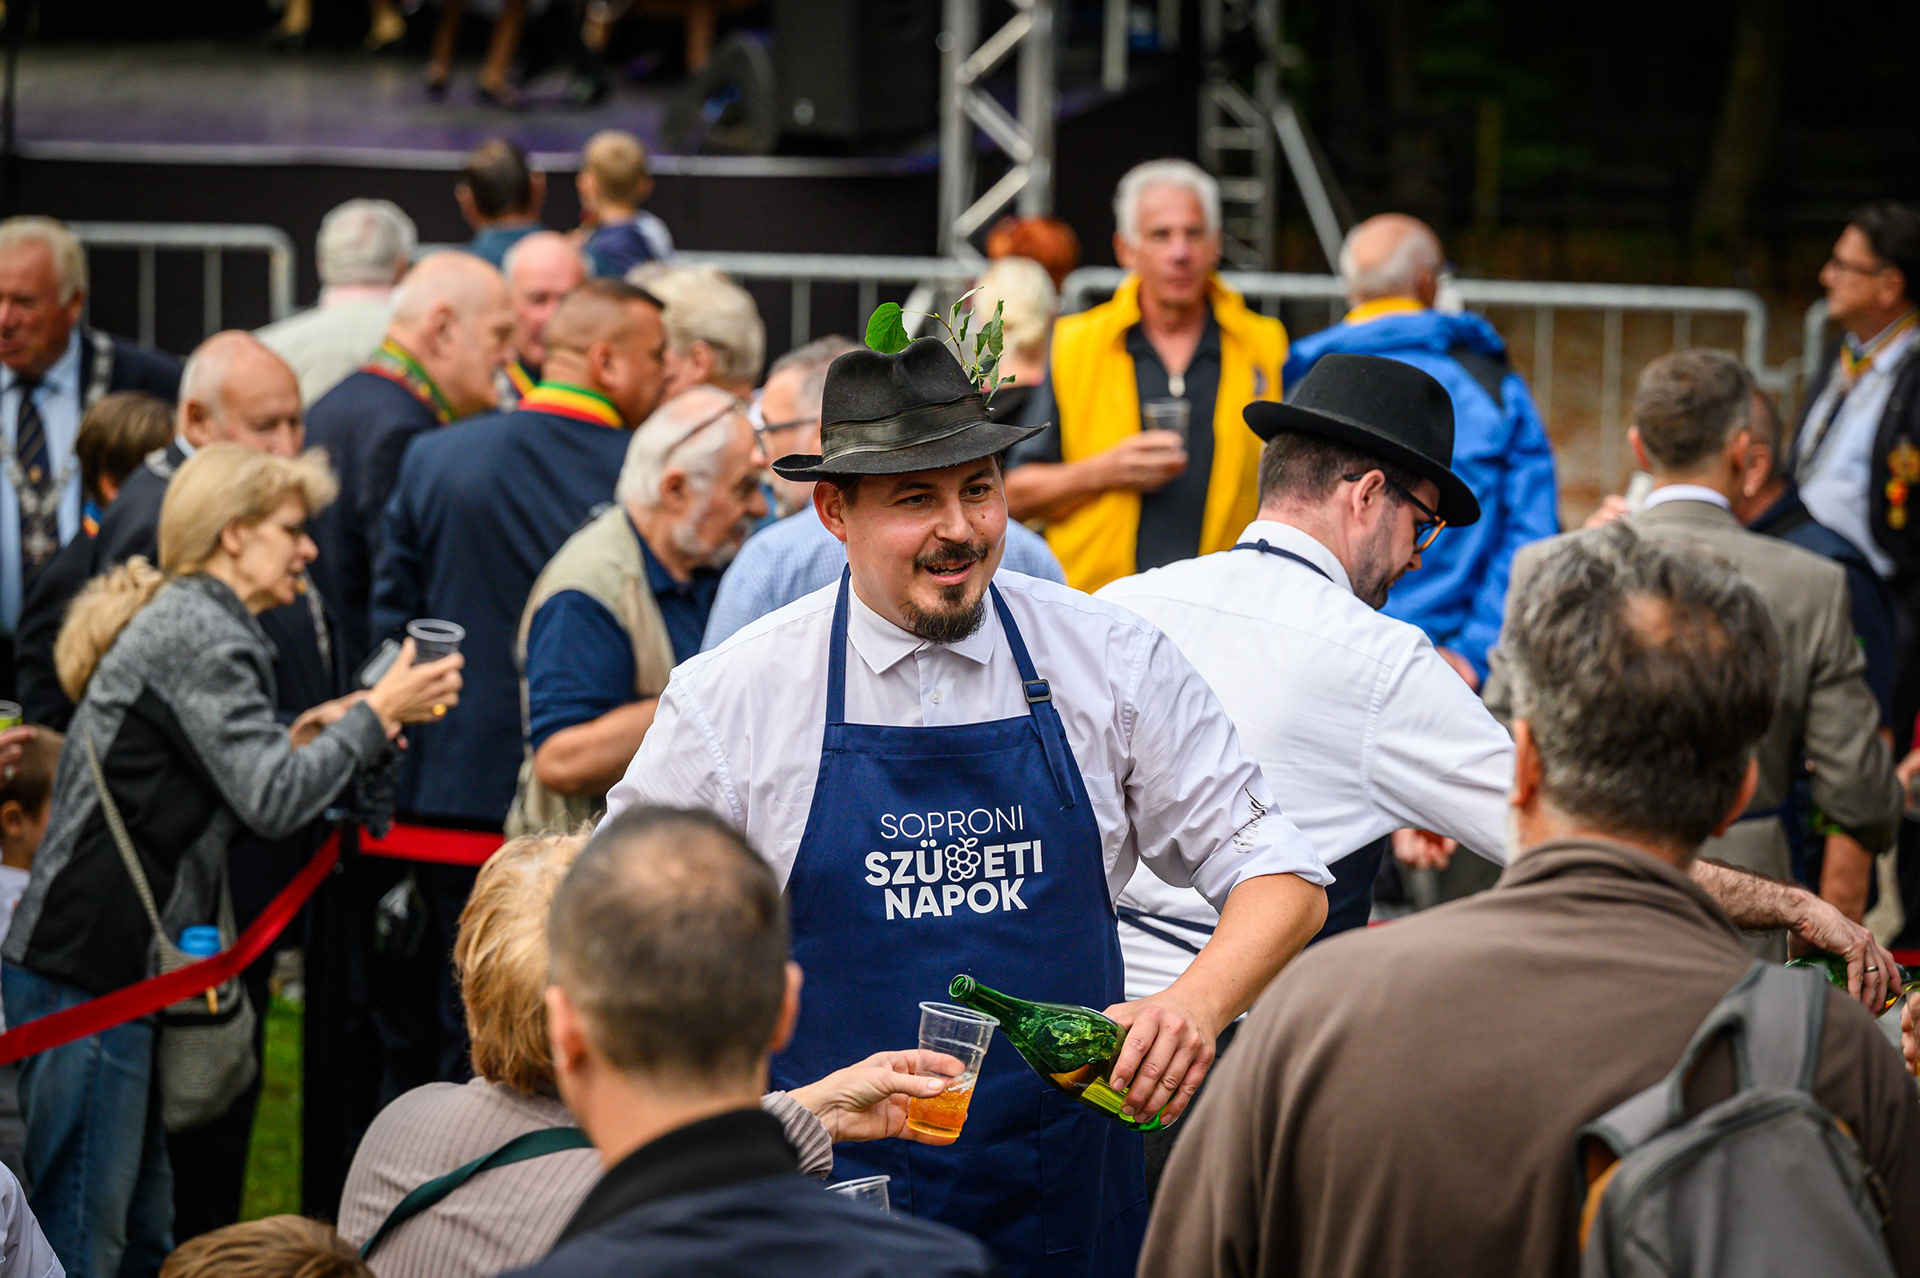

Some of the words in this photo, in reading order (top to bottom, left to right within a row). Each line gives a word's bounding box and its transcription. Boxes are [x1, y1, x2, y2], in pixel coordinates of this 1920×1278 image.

[880, 804, 1024, 839] SOPRONI
[864, 838, 1043, 886] SZÜETI
[884, 877, 1028, 920] NAPOK
